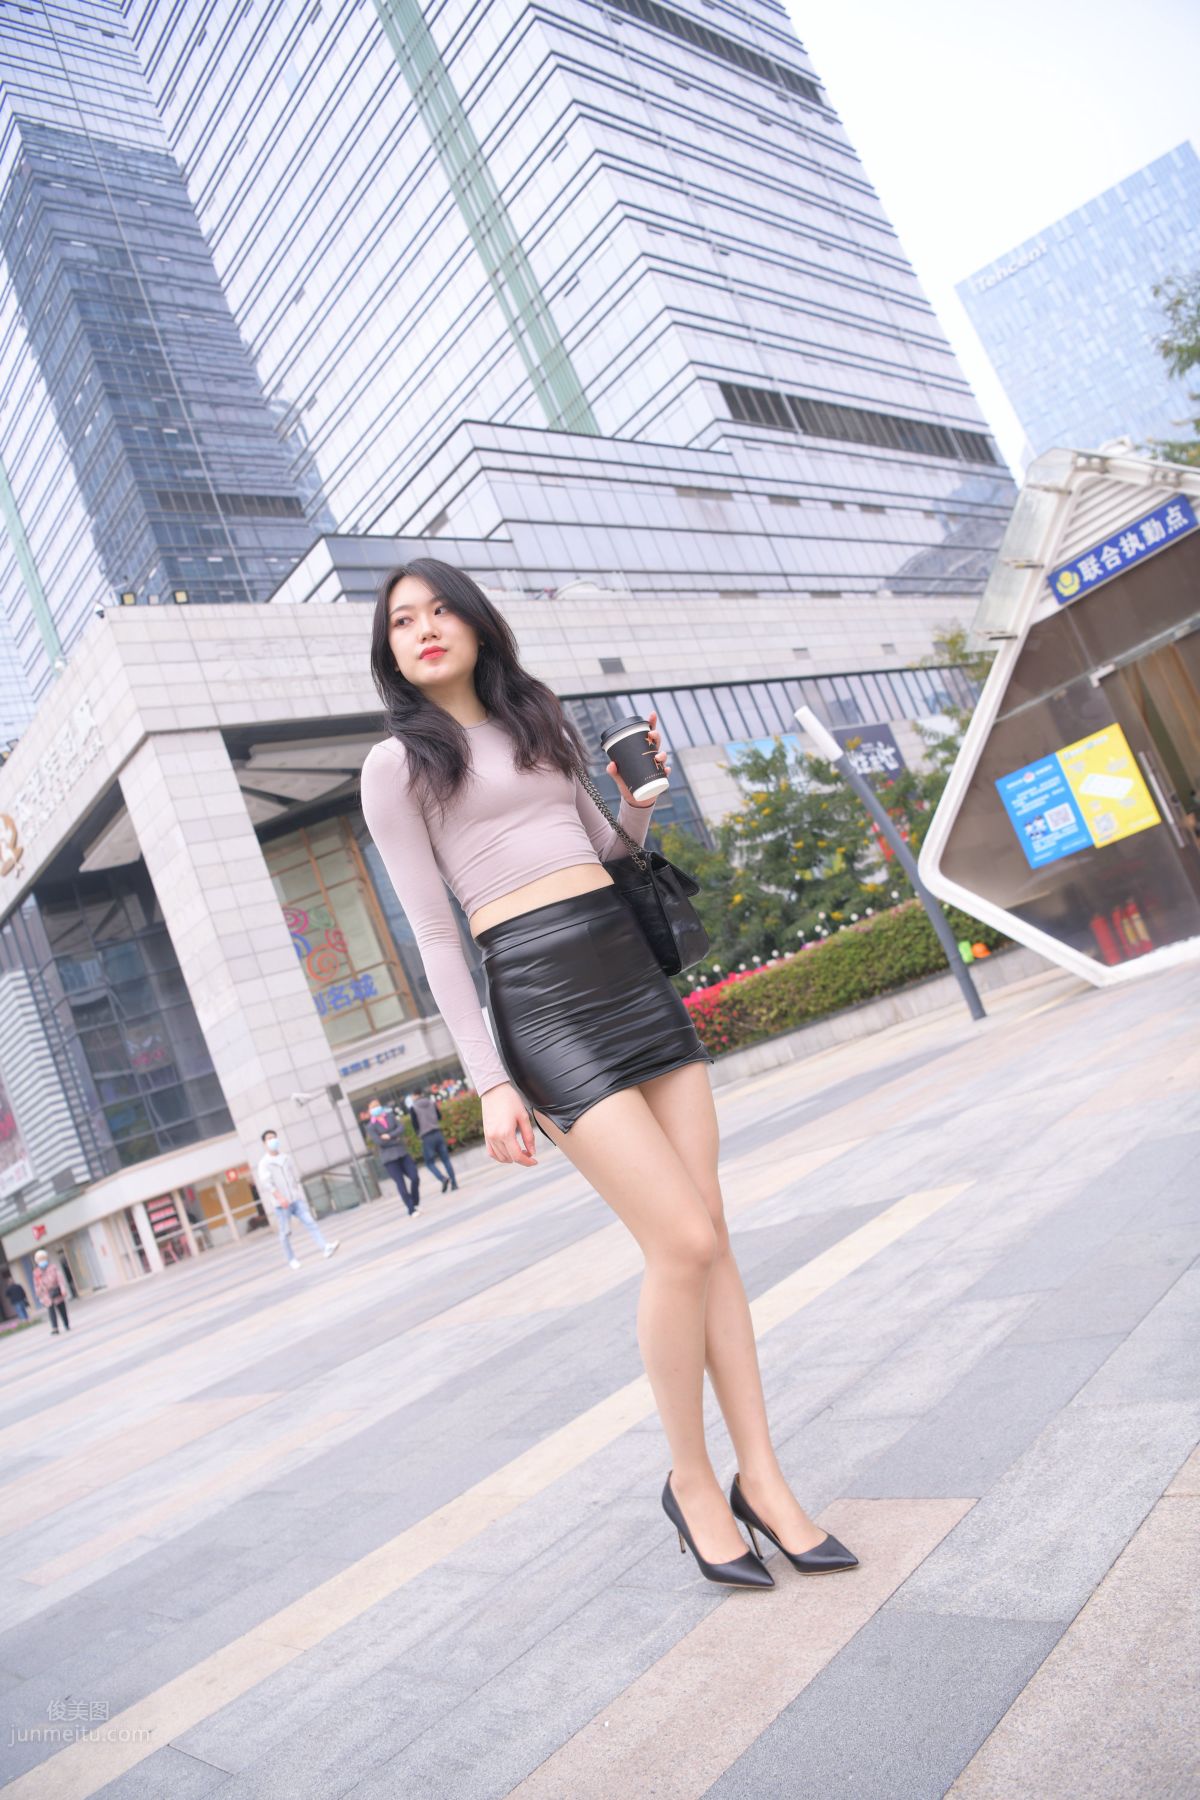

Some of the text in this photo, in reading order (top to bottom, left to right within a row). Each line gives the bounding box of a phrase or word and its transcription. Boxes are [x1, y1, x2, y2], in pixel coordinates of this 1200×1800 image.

[1077, 505, 1189, 582] 联合执勤点
